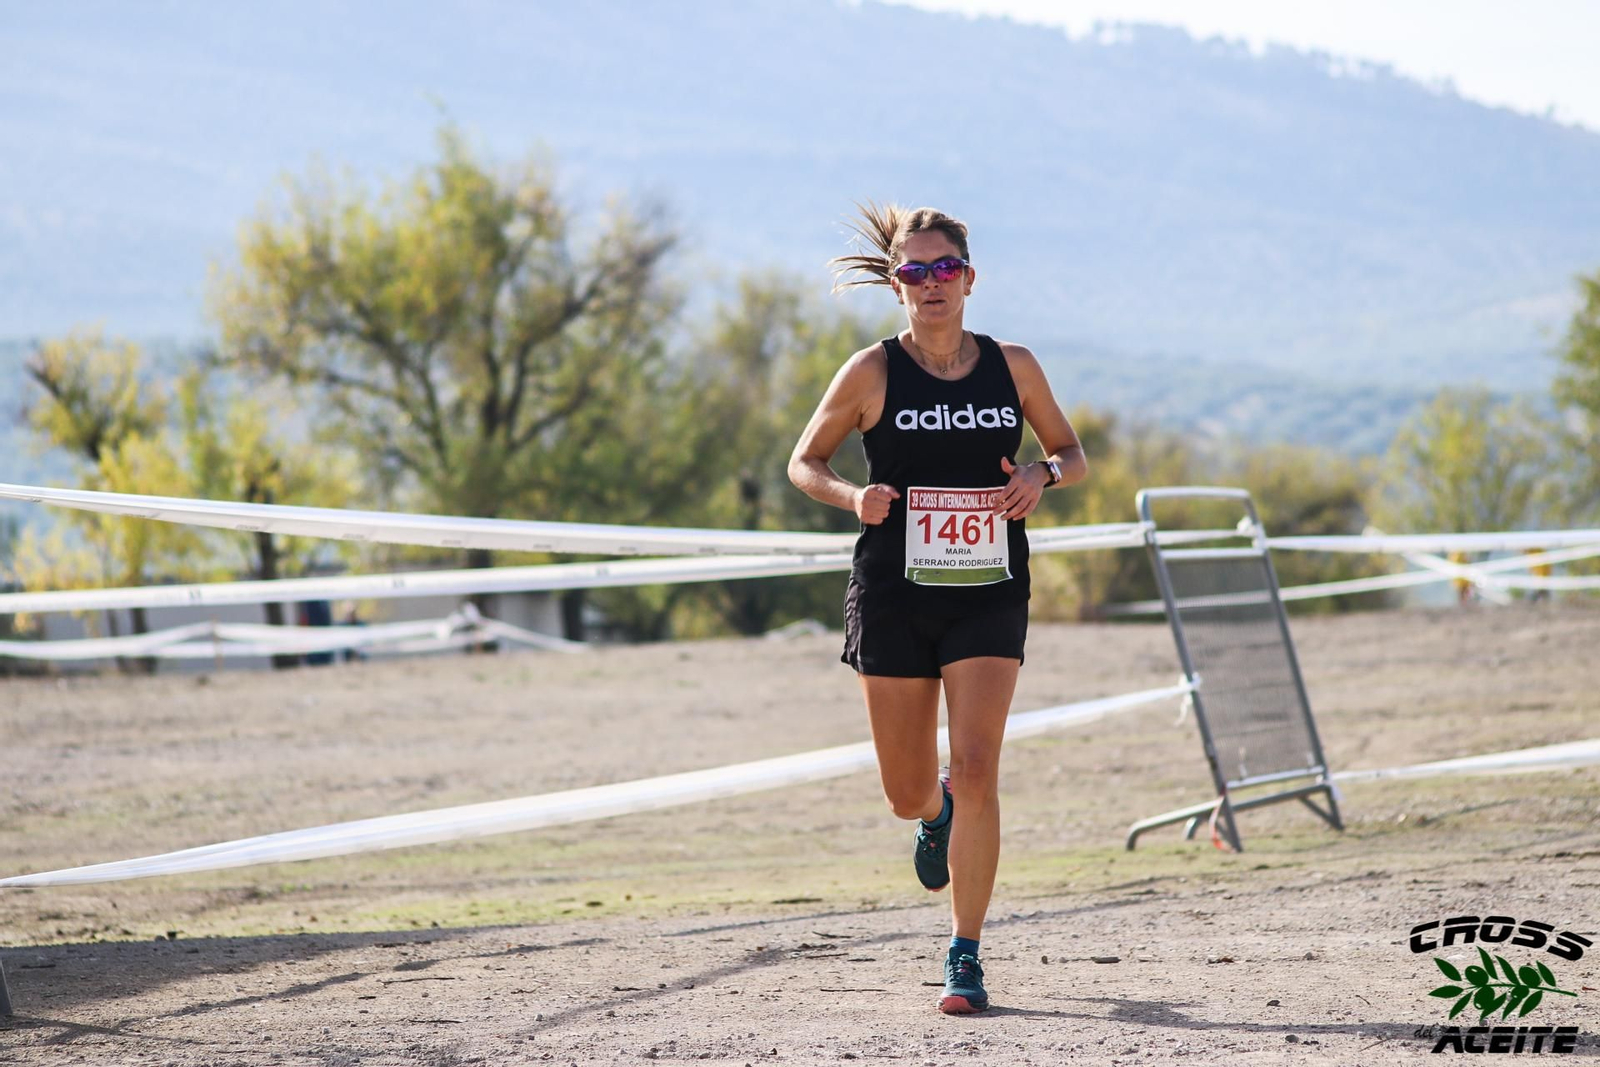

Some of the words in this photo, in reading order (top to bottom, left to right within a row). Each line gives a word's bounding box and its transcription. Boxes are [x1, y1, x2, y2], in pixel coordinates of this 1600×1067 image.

[895, 404, 1017, 430] adidas
[920, 492, 937, 508] CROSS
[938, 493, 980, 509] INTERNACIONAL
[917, 513, 994, 545] 1461
[913, 558, 956, 567] SERRANO
[958, 558, 1003, 567] RODRIGUEZ
